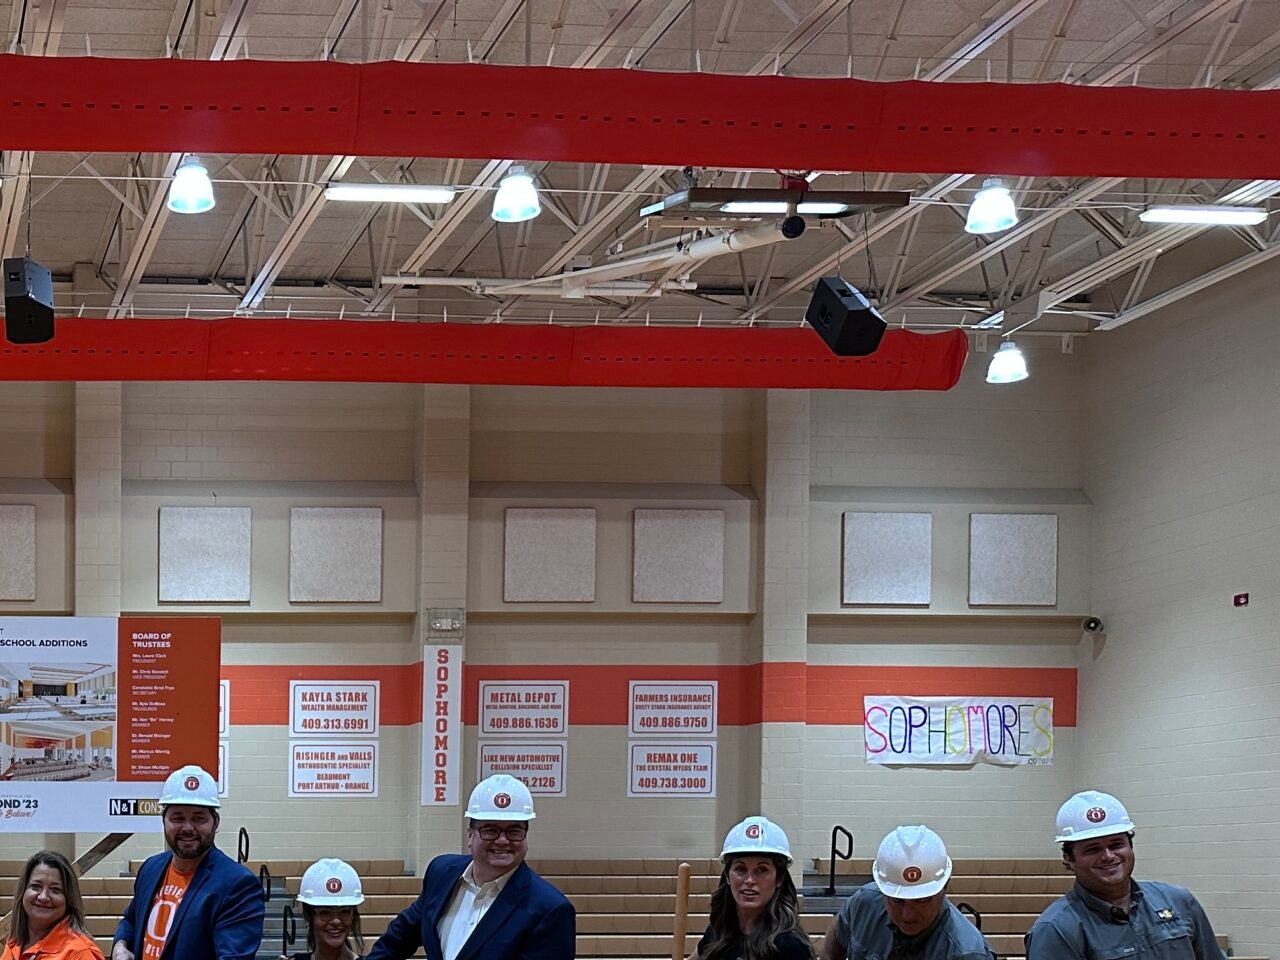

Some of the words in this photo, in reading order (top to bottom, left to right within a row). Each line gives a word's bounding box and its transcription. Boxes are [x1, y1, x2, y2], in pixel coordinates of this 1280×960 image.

[132, 633, 159, 641] BOARD
[161, 633, 172, 641] OF
[0, 639, 37, 647] SCHOOL
[132, 641, 171, 649] TRUSTEES
[301, 692, 332, 702] KAYLA
[335, 692, 368, 703] STARK
[490, 692, 522, 703] METAL
[525, 692, 557, 703] DEPOT
[635, 694, 669, 703] FARMERS
[670, 694, 711, 703] INSURANCE
[326, 704, 368, 712] MANAGEMENT
[301, 718, 368, 729] 409.313.6991
[434, 648, 449, 802] SOPHOMORE
[489, 717, 558, 729] 409.886.1636
[639, 717, 707, 728] 409.886.9750
[865, 705, 1053, 756] SOPHOMORES
[296, 752, 336, 761] RISINGER
[349, 752, 372, 761] VALLS
[484, 755, 498, 763] LIKE
[500, 755, 516, 763] NEW
[516, 755, 561, 763] AUTOMOTIVE
[646, 753, 678, 763] REMAX
[680, 753, 698, 763] ONE
[317, 773, 351, 781] BEAUMONT
[638, 778, 706, 788] 409.738.3000
[22, 799, 39, 809] '23
[111, 800, 137, 815] N&T
[5, 808, 37, 819] Believe!
